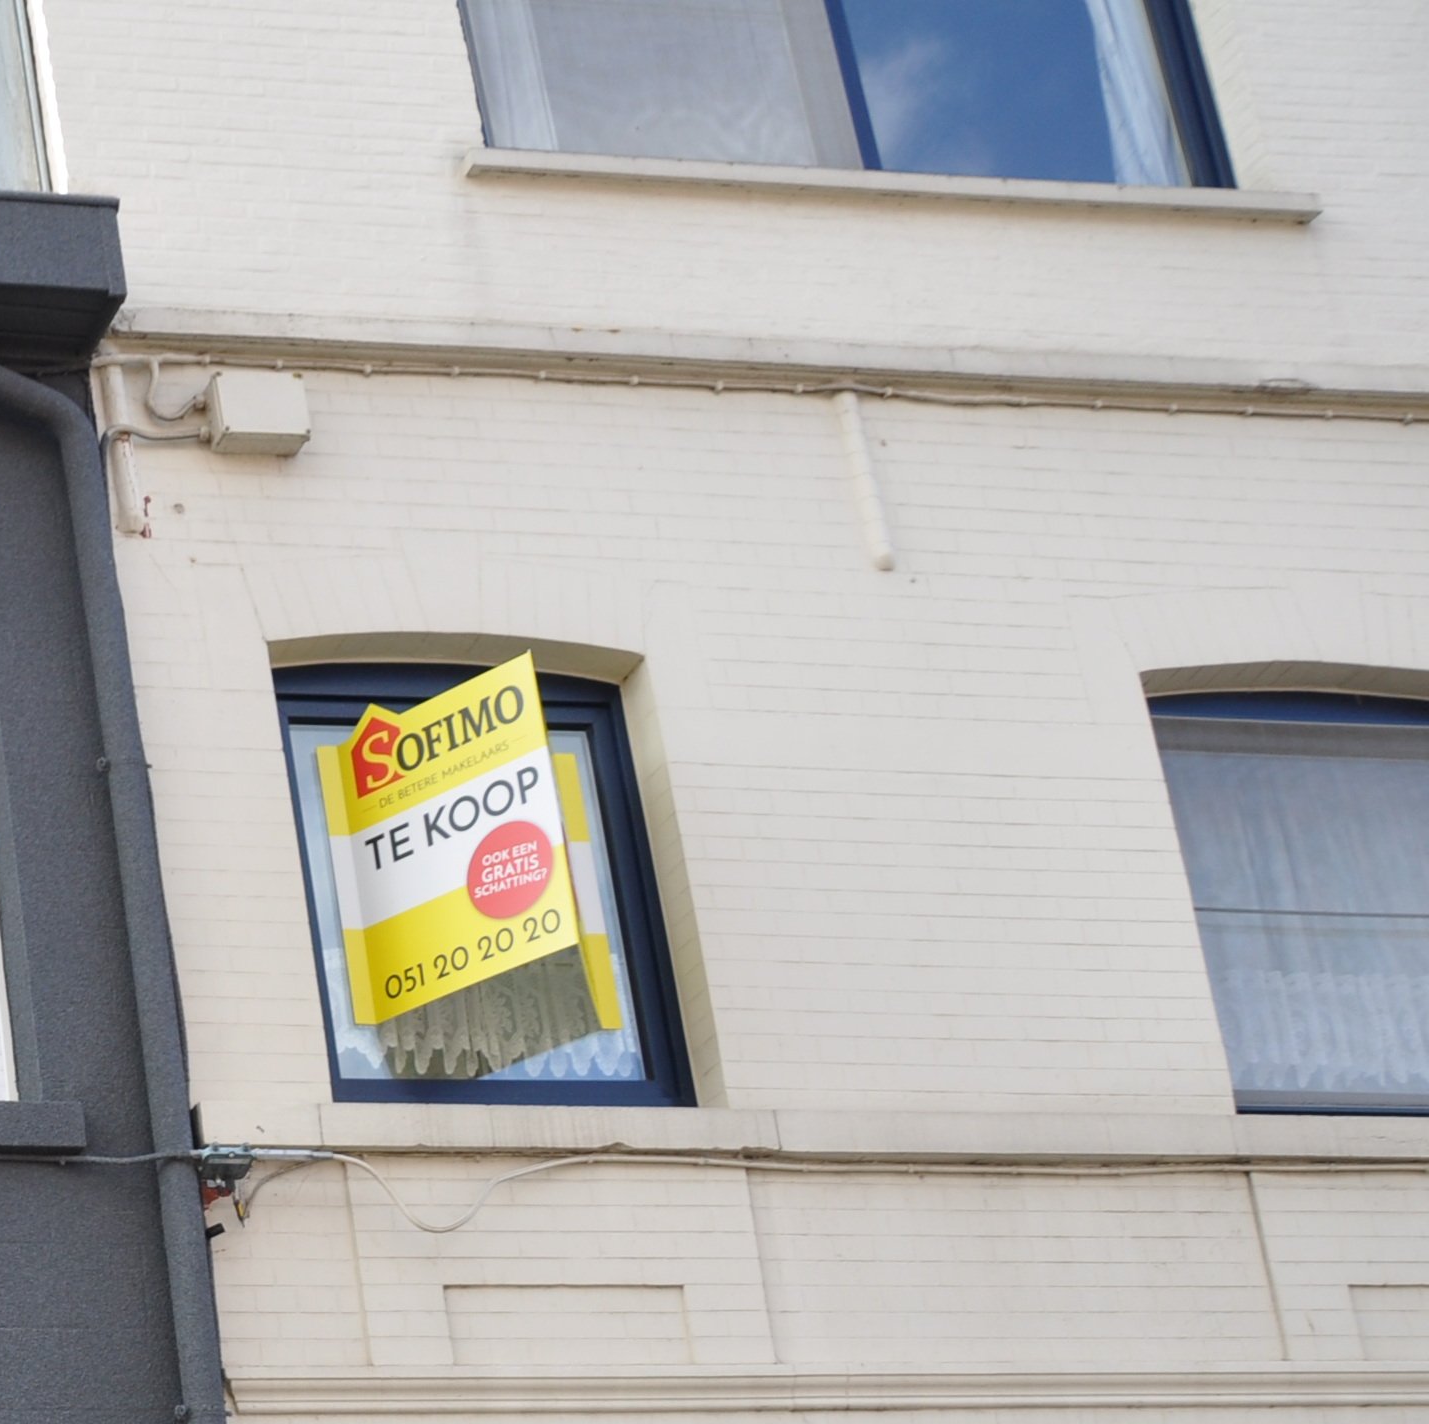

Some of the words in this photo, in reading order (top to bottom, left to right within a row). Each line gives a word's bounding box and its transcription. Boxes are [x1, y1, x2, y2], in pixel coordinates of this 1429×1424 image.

[362, 685, 524, 790] SOFIMO
[379, 794, 395, 808] DE
[398, 773, 438, 799] BETERE
[442, 740, 509, 780] MAKELAARS
[365, 822, 414, 870] TE
[425, 766, 539, 847] KOOP
[474, 868, 548, 898] SCHATTING?
[482, 849, 509, 865] OOK
[512, 841, 537, 857] EEN
[482, 855, 539, 883] GRATIS
[385, 963, 425, 999] 051
[433, 947, 469, 979] 20
[477, 928, 513, 961] 20
[523, 909, 560, 943] 20
